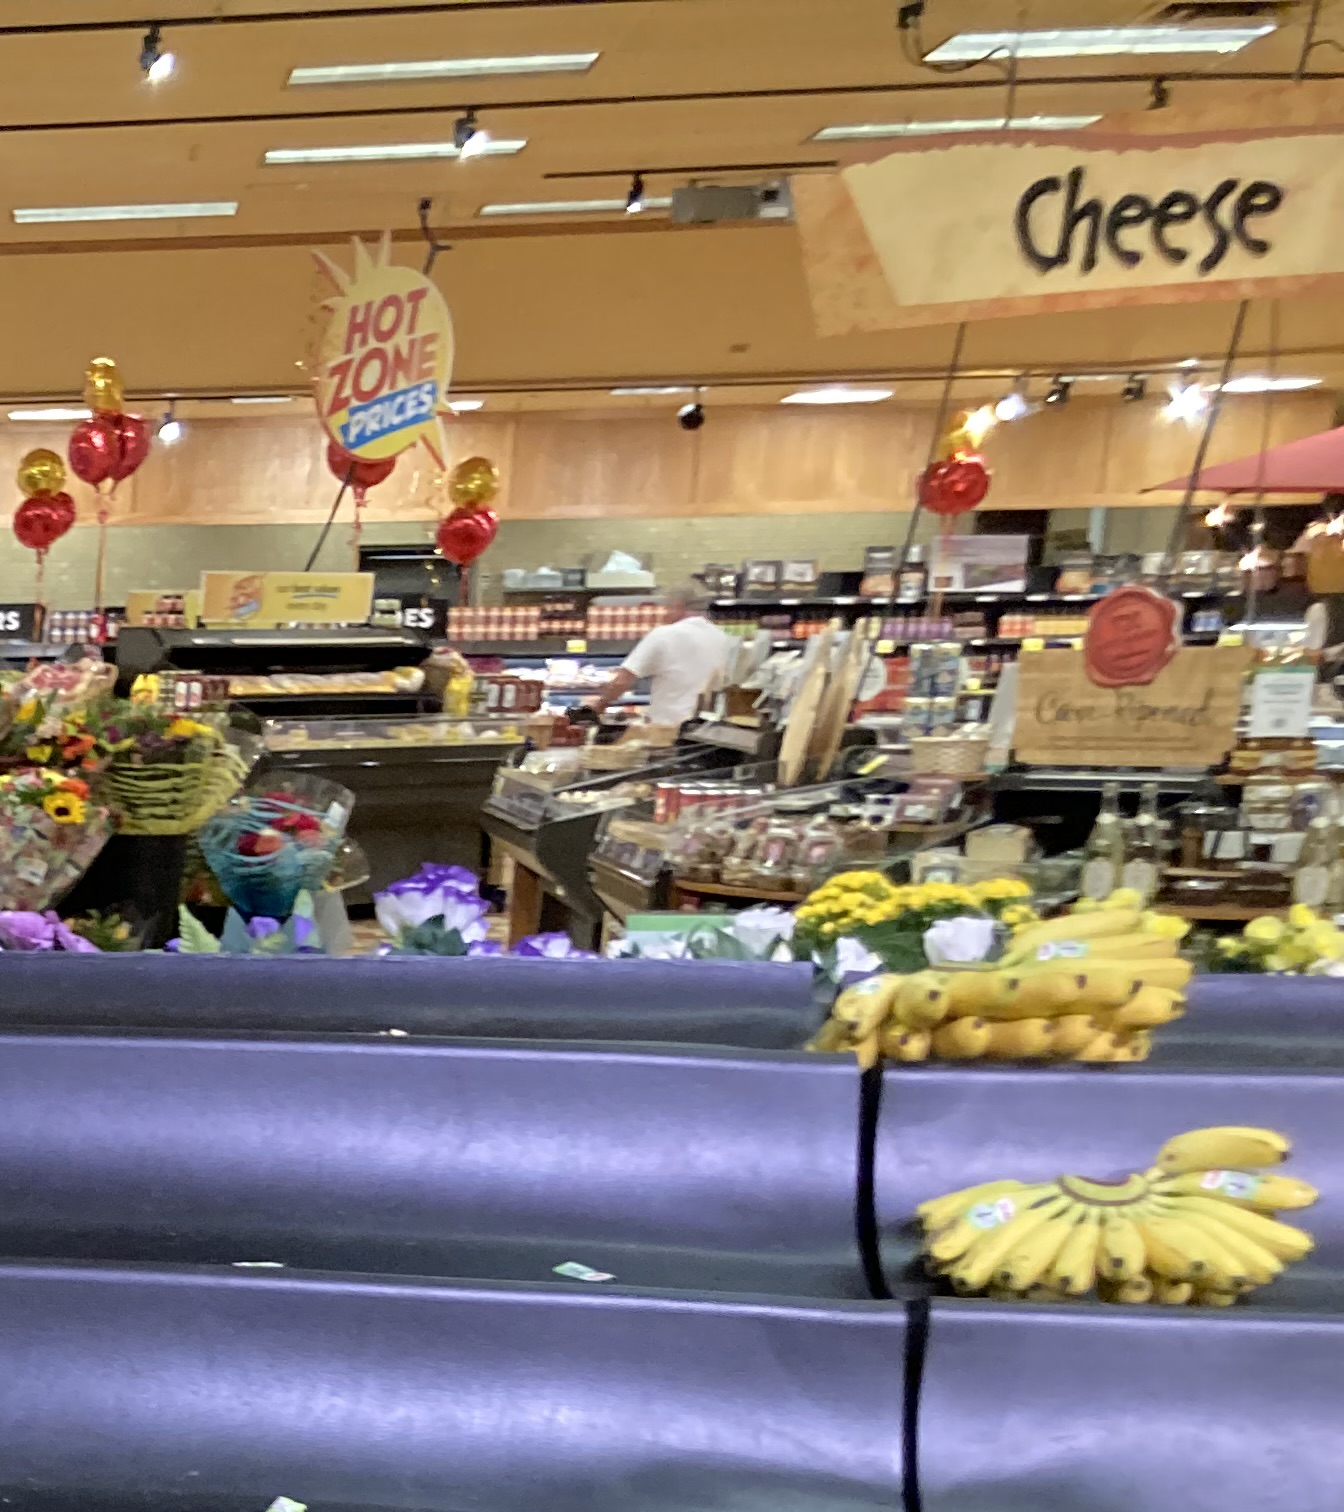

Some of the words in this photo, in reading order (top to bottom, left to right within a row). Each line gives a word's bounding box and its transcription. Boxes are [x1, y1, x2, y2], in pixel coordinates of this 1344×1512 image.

[1014, 165, 1283, 274] Cheese
[344, 287, 429, 354] HOT
[326, 332, 439, 416] ZONE
[346, 382, 434, 443] PRICES
